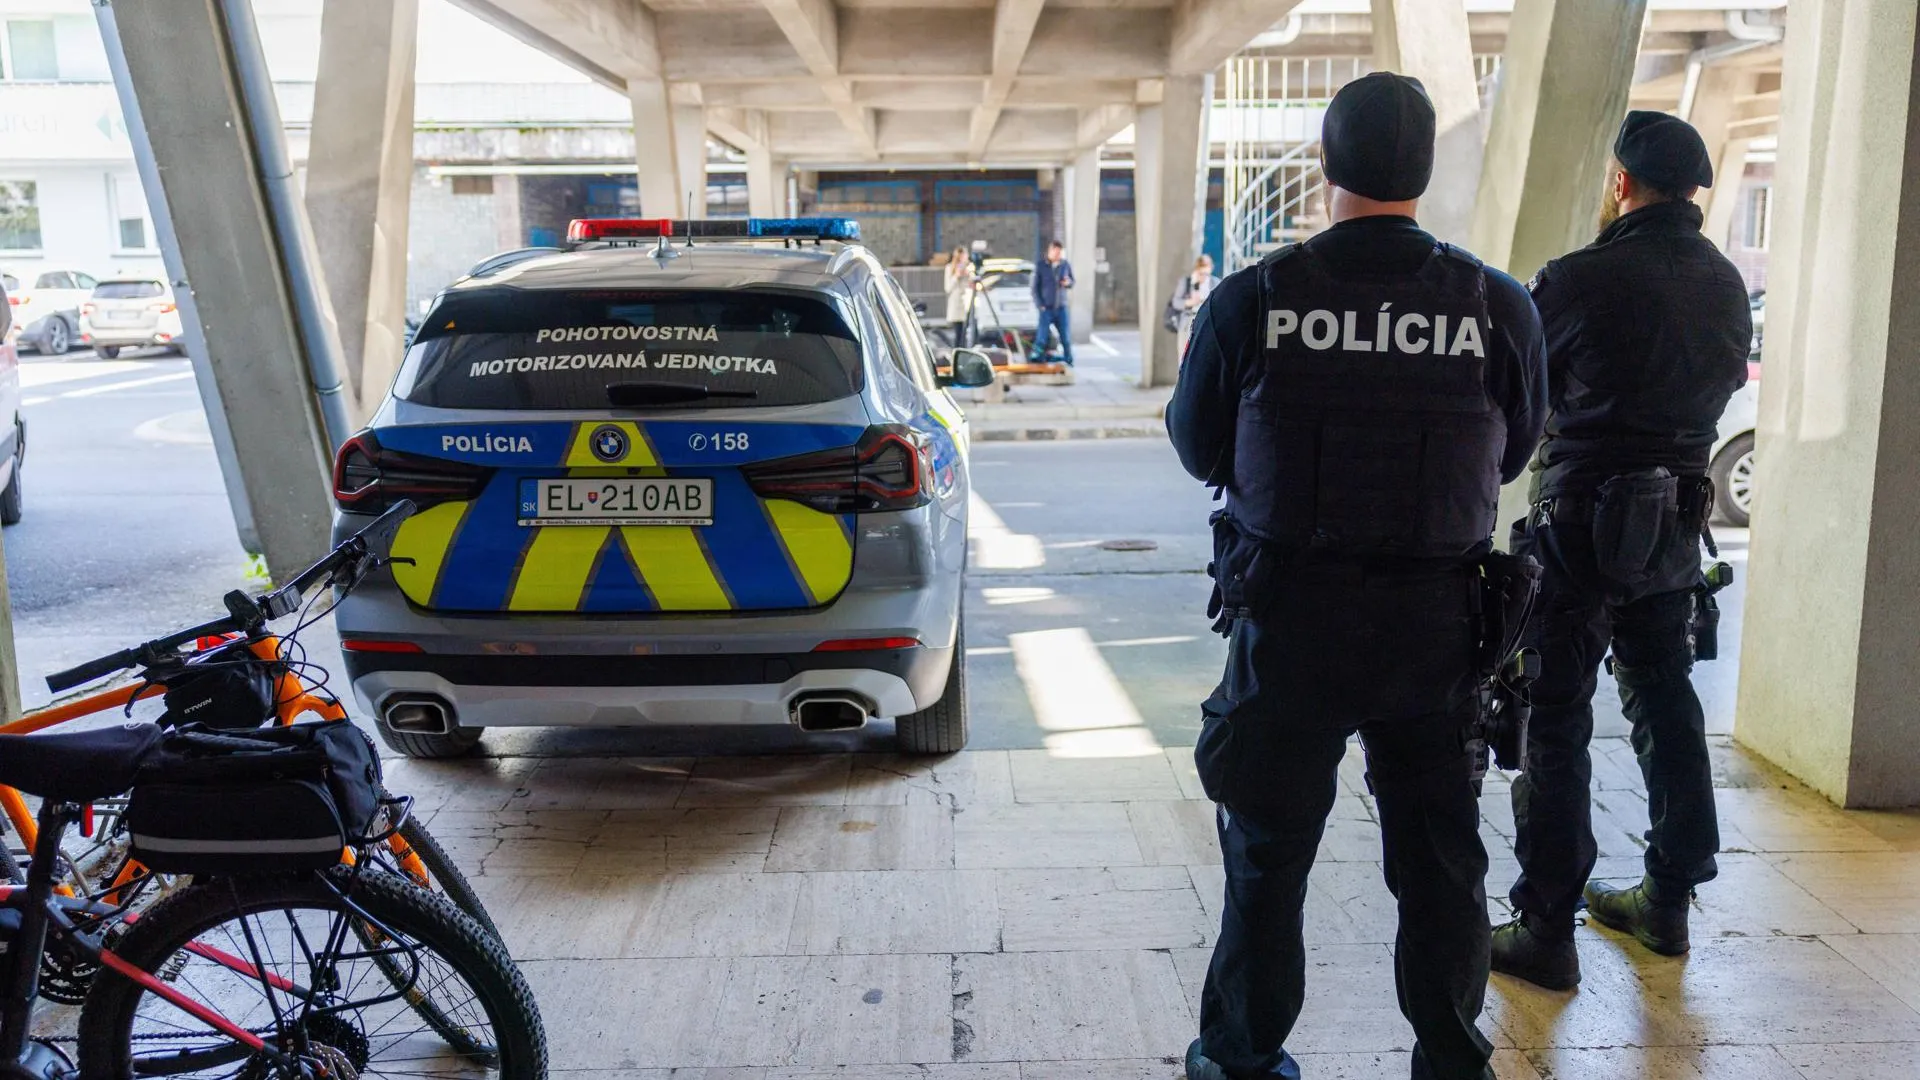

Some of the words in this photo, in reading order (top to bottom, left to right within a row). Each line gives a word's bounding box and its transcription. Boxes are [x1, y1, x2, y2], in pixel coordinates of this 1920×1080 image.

[536, 325, 719, 343] POHOTOVOSTNÁ
[1266, 302, 1485, 358] POLÍCIA
[469, 350, 647, 378] MOTORIZOVANÁ
[654, 353, 778, 375] JEDNOTKA
[441, 433, 533, 453] POLÍCIA
[710, 432, 750, 451] 158
[522, 502, 537, 512] SK
